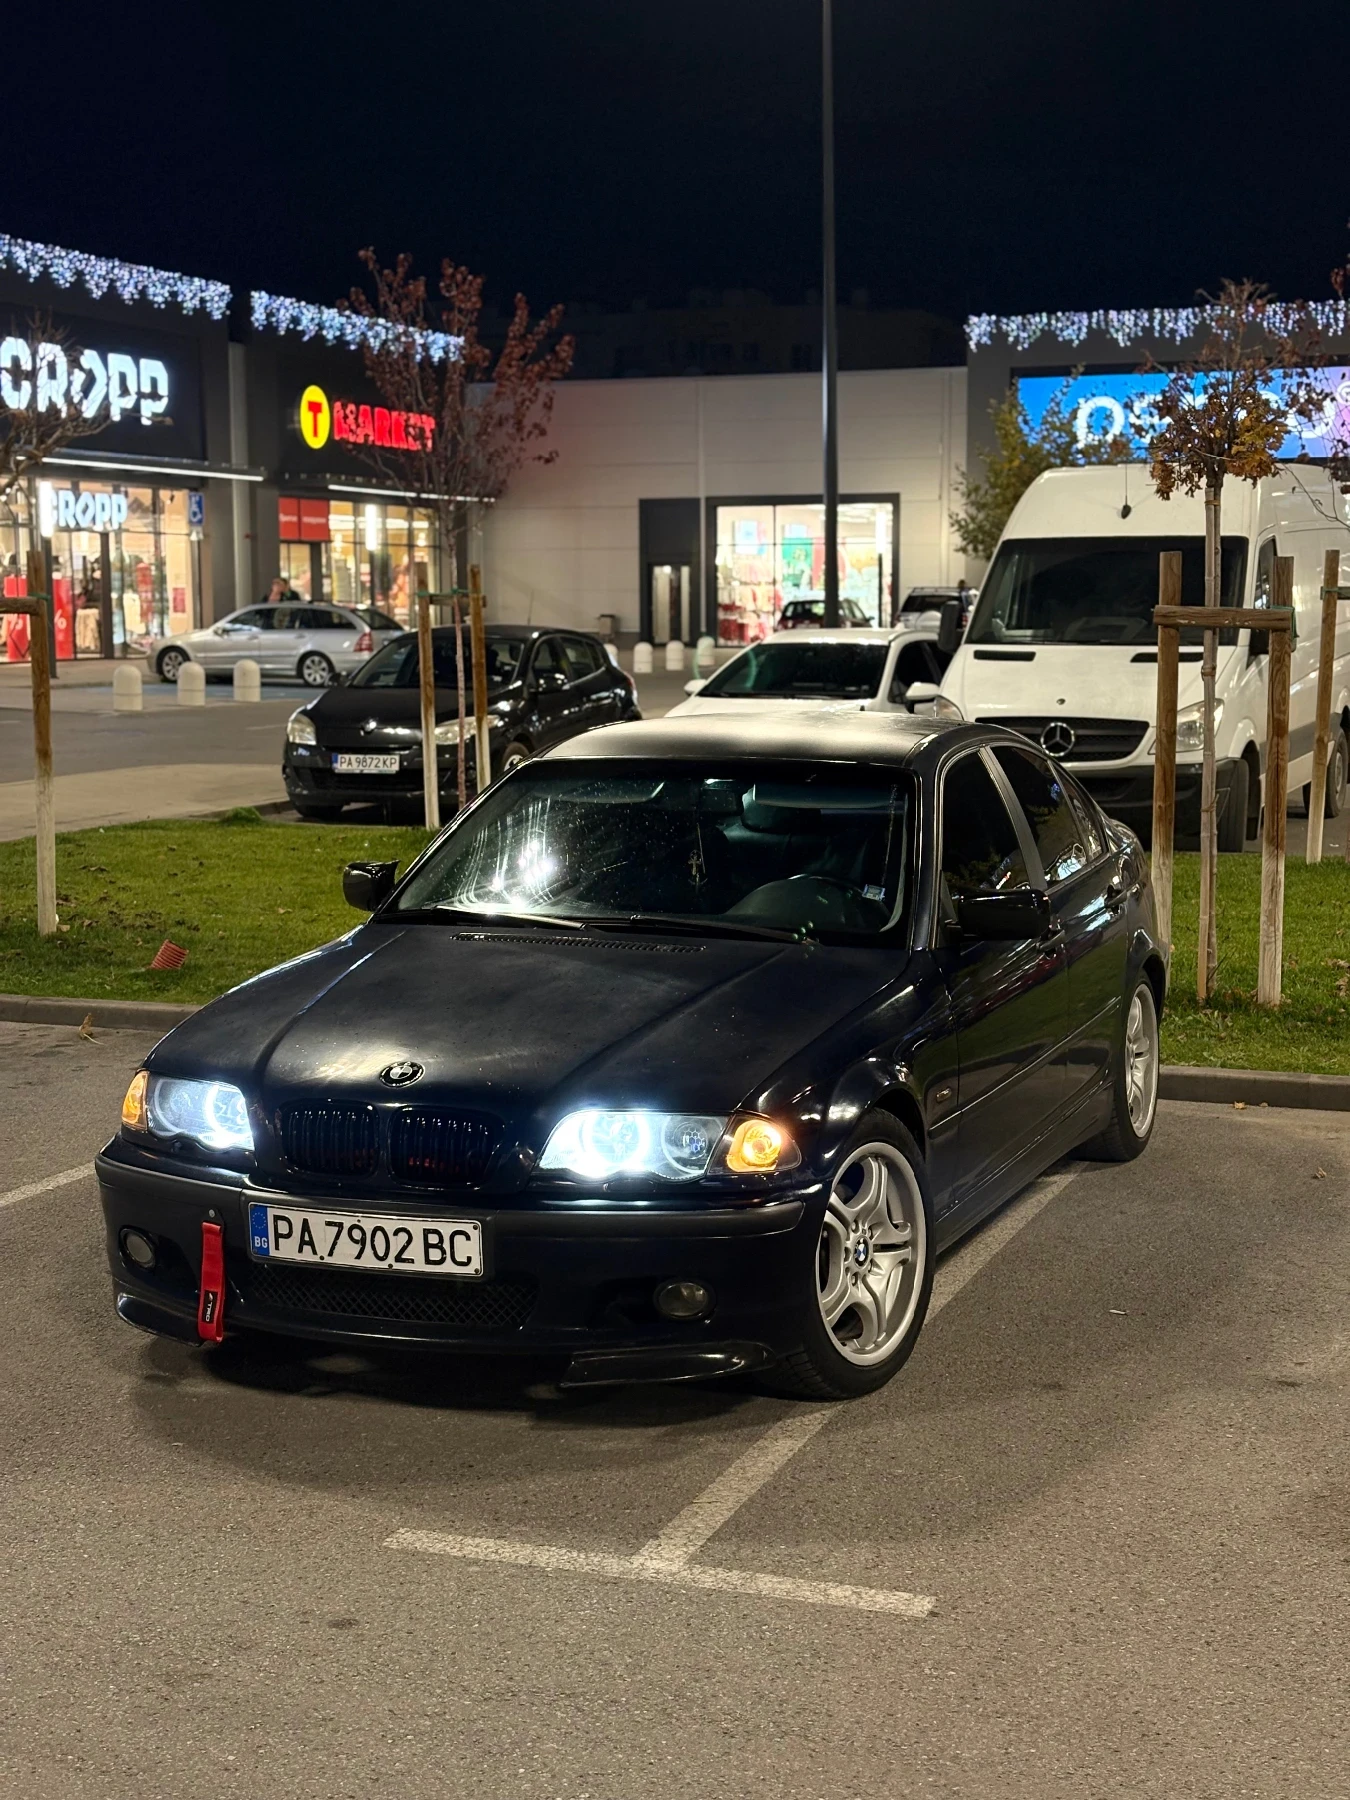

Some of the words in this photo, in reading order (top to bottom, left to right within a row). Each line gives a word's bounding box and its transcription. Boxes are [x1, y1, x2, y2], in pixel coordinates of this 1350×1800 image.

[0, 336, 169, 425] CROPP
[307, 400, 323, 438] T
[253, 1235, 268, 1249] BG
